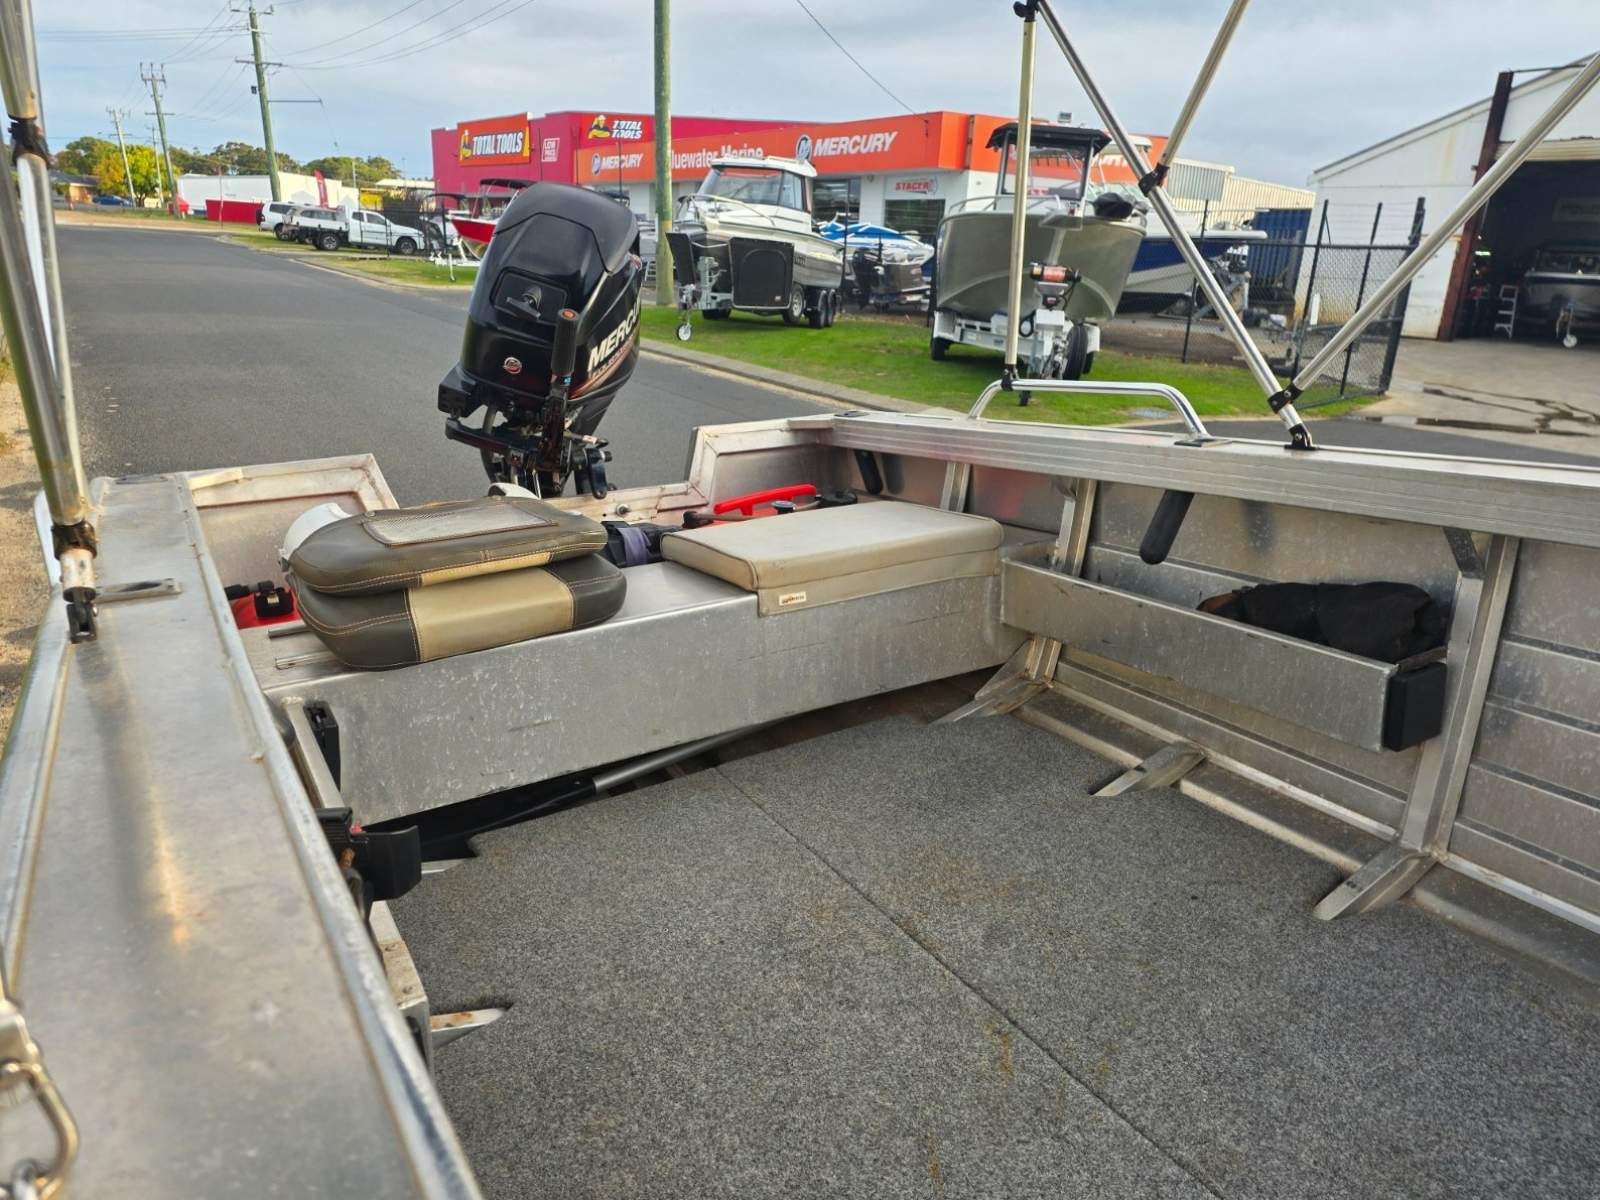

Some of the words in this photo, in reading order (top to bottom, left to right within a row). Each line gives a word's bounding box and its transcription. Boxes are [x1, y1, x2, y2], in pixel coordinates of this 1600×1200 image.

[611, 130, 643, 139] TOOLS
[612, 120, 642, 130] TOTAL
[472, 134, 495, 156] TOTAL
[495, 131, 524, 154] TOOLS
[813, 131, 898, 157] MERCURY
[601, 153, 644, 170] MERCURY
[672, 148, 719, 169] luewater
[587, 294, 640, 373] MERCU
